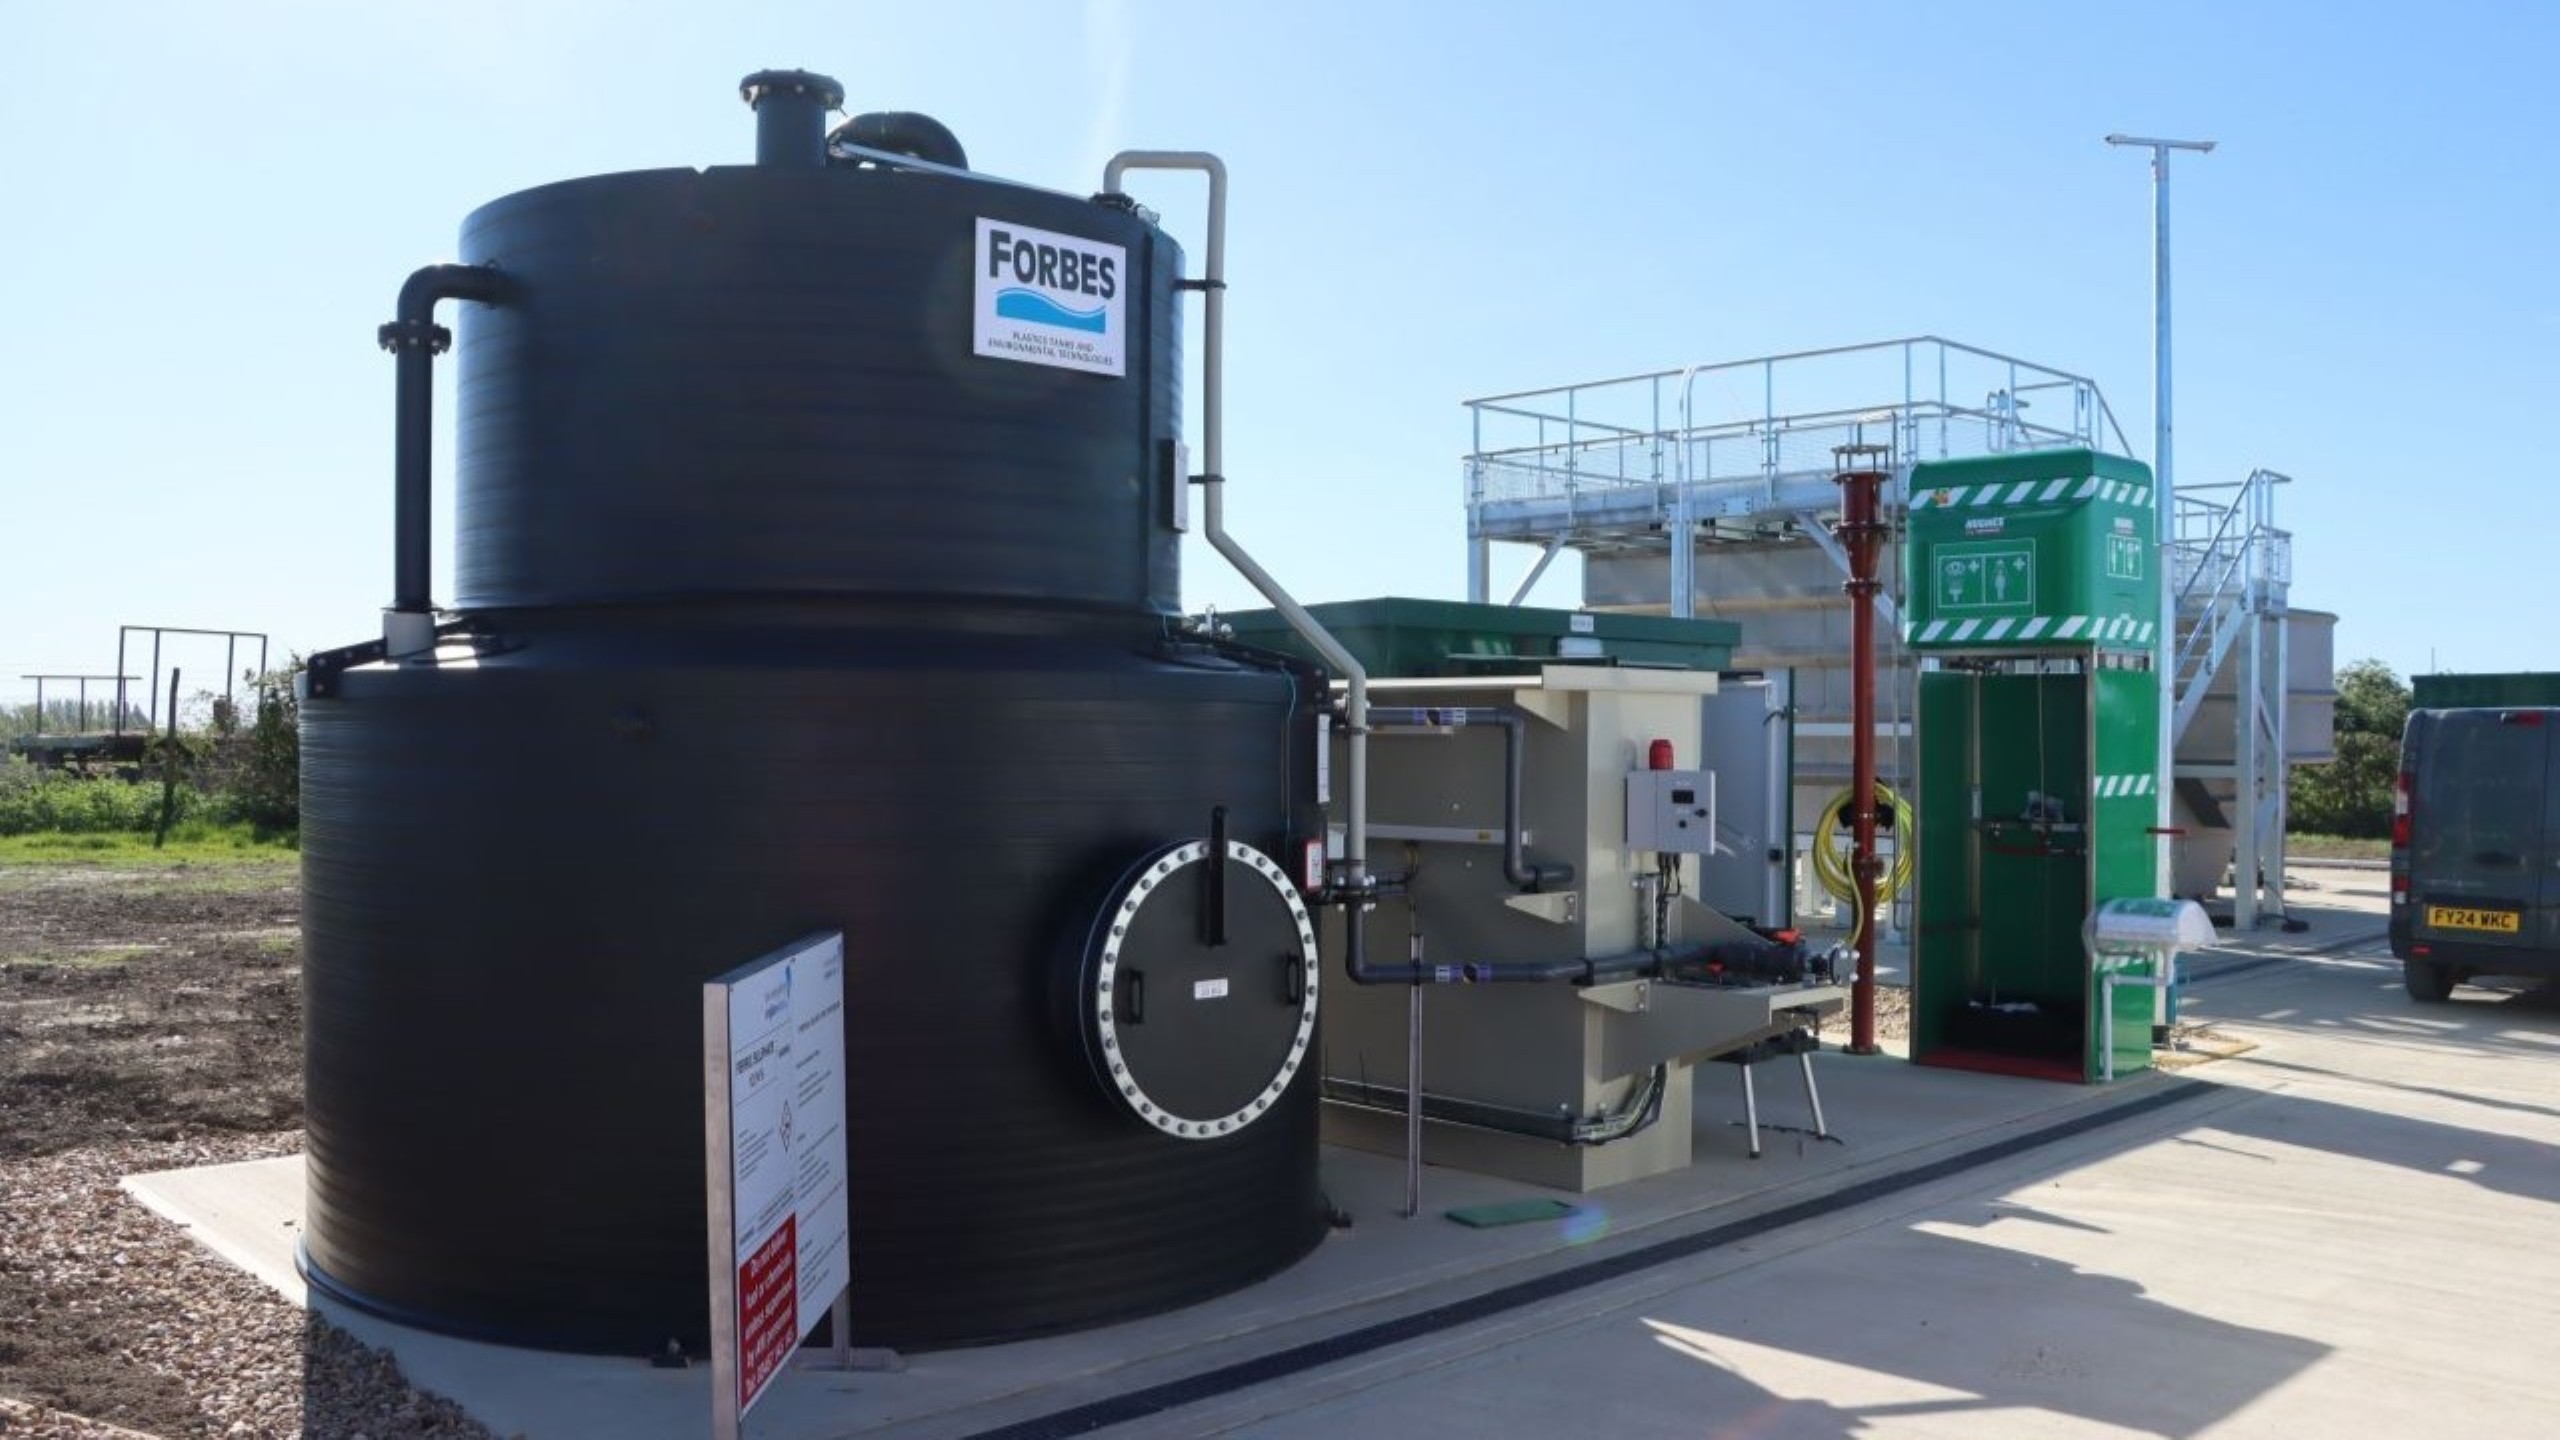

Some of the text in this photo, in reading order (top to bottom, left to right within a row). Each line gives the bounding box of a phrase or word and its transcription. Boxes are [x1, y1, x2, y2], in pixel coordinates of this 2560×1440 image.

[989, 229, 1116, 300] FORBES
[988, 338, 1113, 365] ENVIRONMENTAL TECHNOLOGIES
[1013, 332, 1049, 345] PLASTICS
[1076, 341, 1094, 352] AND
[2435, 909, 2511, 929] FY24 WKC
